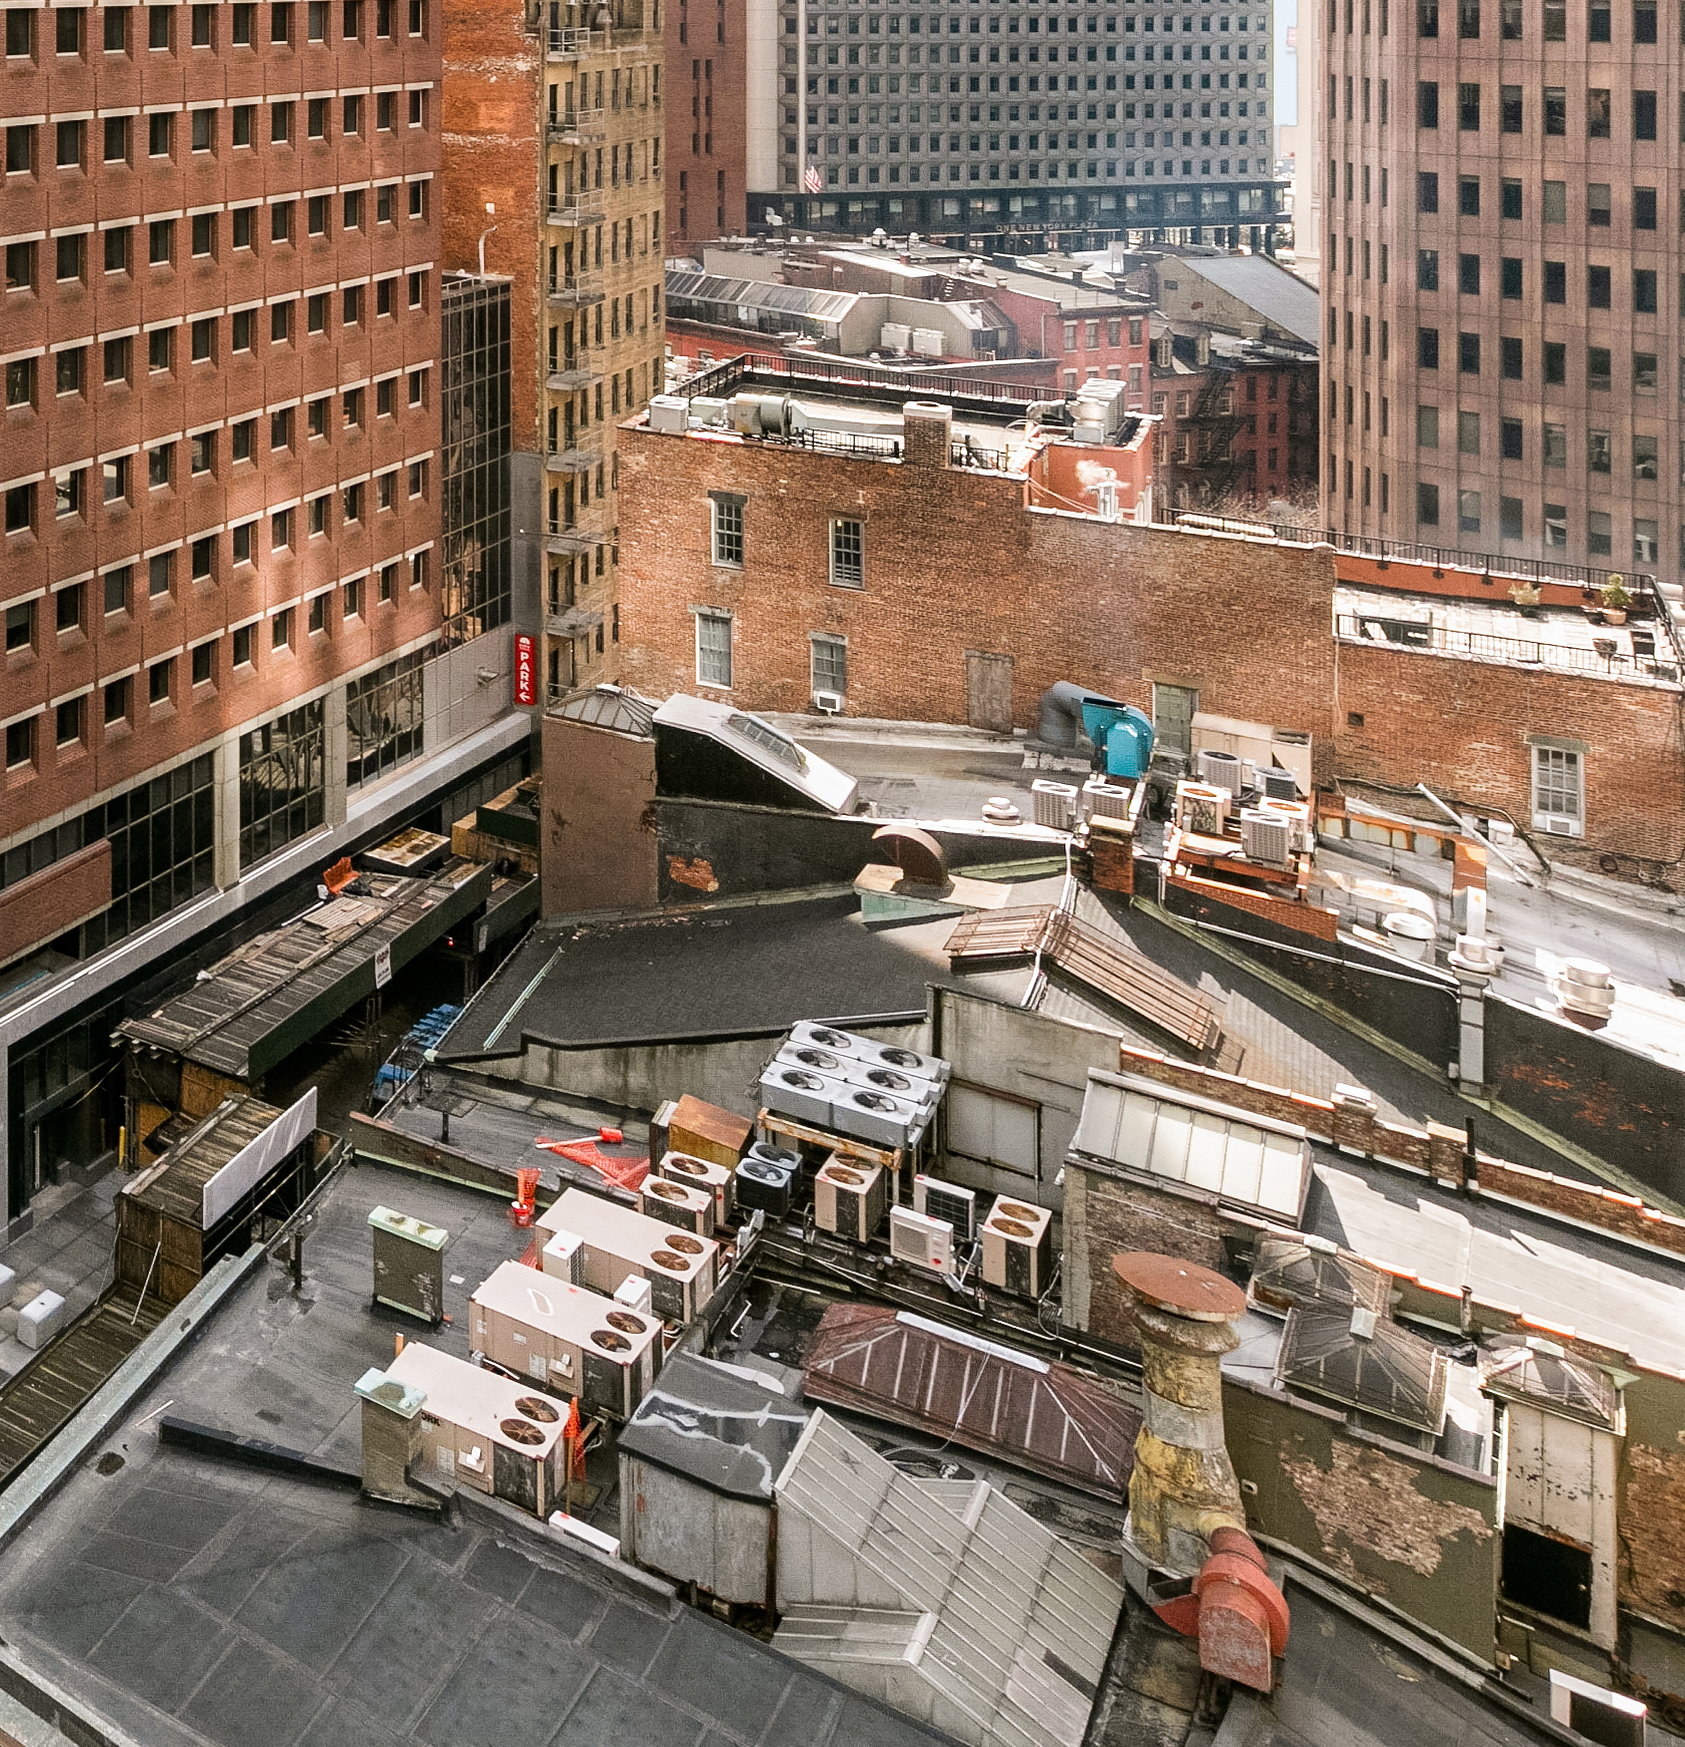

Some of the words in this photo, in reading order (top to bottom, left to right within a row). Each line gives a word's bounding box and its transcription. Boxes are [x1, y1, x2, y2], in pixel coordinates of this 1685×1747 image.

[995, 224, 1017, 232] ONE
[1019, 223, 1041, 231] NEW
[1042, 222, 1068, 231] YORK
[1069, 222, 1099, 230] PLAZA
[519, 651, 530, 692] PARK
[421, 1411, 441, 1427] ORK
